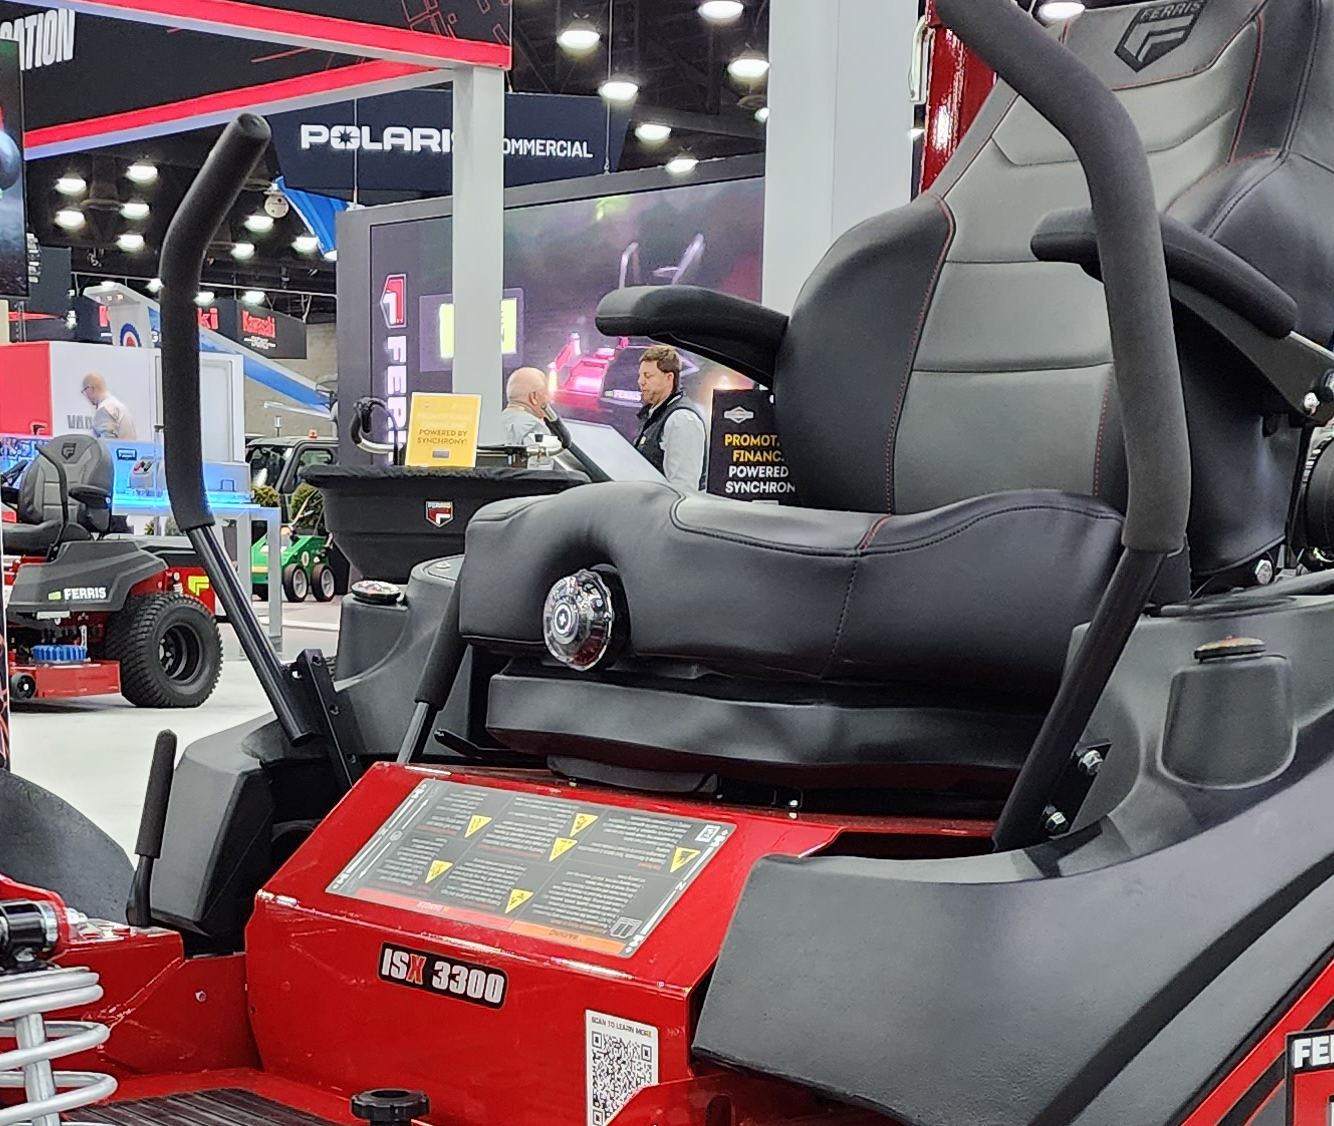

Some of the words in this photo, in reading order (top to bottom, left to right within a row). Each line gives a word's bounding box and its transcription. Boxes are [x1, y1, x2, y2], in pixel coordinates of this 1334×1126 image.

[300, 124, 454, 152] POLARI
[503, 137, 593, 158] OMMERCIAL
[724, 433, 780, 447] PROMOT
[732, 450, 785, 462] FINANC
[728, 465, 789, 478] POWERED
[725, 480, 795, 493] SYNCHRON
[63, 587, 107, 600] FERRIS
[381, 948, 427, 985] ISX
[431, 961, 505, 1004] 3300
[608, 1020, 615, 1028] TO
[616, 1022, 634, 1033] LEARN
